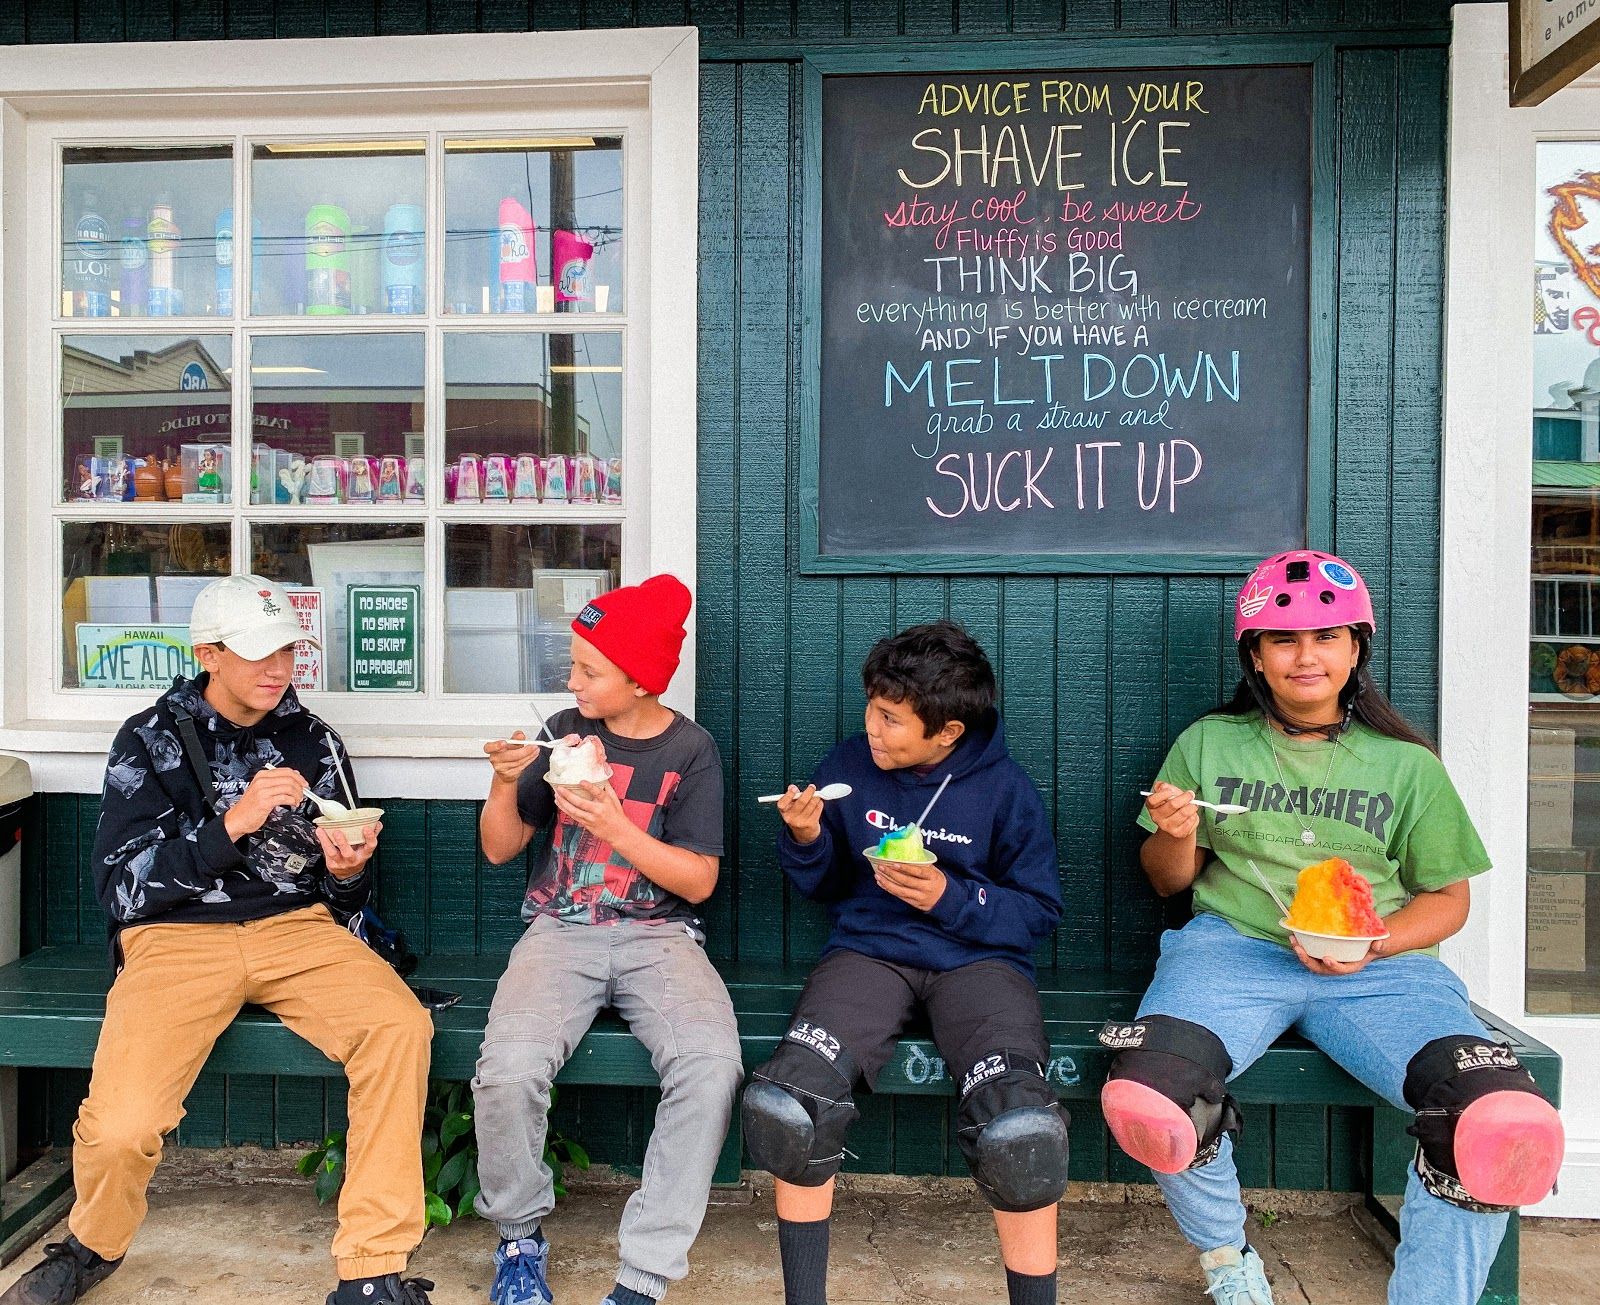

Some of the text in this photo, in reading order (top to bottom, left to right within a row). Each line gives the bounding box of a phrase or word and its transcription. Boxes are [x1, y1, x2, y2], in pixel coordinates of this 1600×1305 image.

[1545, 28, 1552, 40] e
[918, 82, 1030, 116] ADVICE
[1041, 80, 1112, 115] FROM
[897, 119, 1191, 190] SHAVE ICE
[884, 195, 967, 250] stay
[1060, 193, 1096, 222] be
[1102, 191, 1202, 222] sweet
[957, 224, 1123, 260] Fluffy is Good
[923, 252, 1139, 295] THINK BIG
[856, 297, 988, 335] everything
[1005, 299, 1024, 321] is
[1035, 297, 1110, 321] better
[1118, 297, 1161, 321] with
[920, 325, 1150, 355] AND IF YOU HAVE A
[1083, 350, 1240, 403] DOWN
[911, 400, 1175, 459] grab a straw and
[926, 439, 1202, 518] SUCK IT UP
[124, 631, 164, 640] HAWAII
[377, 617, 406, 631] SHIRT
[83, 644, 197, 681] LIVE ALOH
[377, 637, 406, 652] SKIRT
[865, 809, 973, 845] Chpion
[1214, 776, 1394, 845] THRASHER
[789, 1030, 837, 1061] KILLER PADS
[797, 1023, 840, 1051] 187
[1457, 1044, 1508, 1061] 187
[964, 1055, 1002, 1085] 187
[983, 1063, 1006, 1077] PADS
[1457, 1056, 1491, 1070] KILLER
